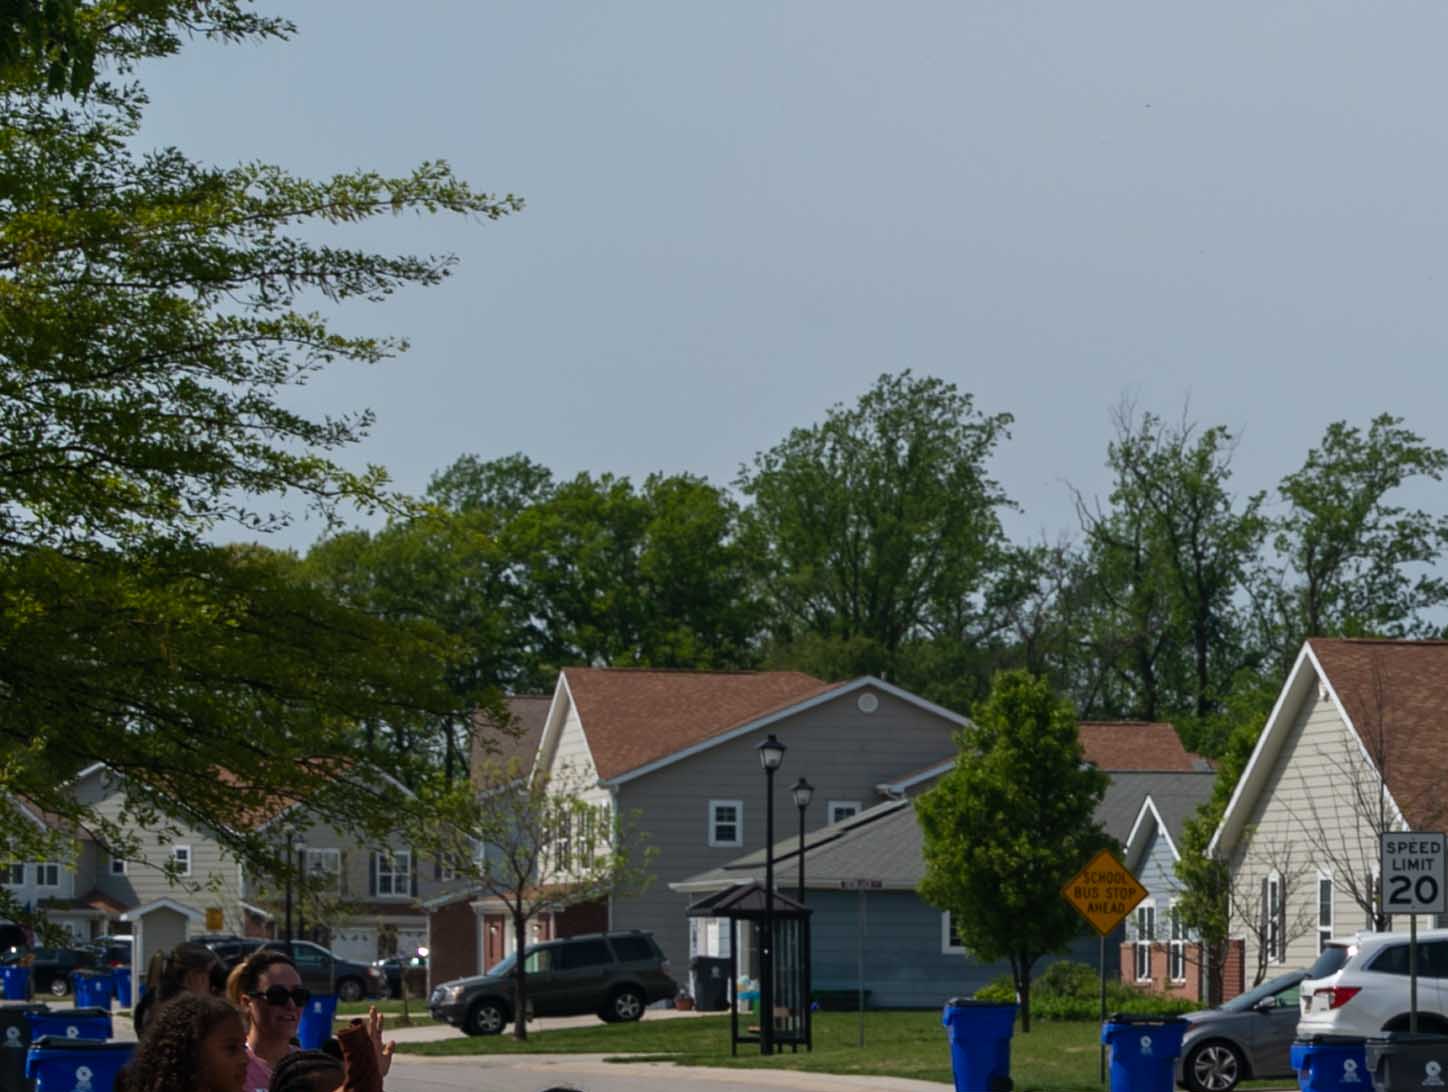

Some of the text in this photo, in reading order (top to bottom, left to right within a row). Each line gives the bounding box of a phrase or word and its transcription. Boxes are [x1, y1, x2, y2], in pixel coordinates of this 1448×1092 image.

[1386, 841, 1441, 855] SPEED
[1392, 858, 1435, 872] LIMIT
[1083, 871, 1128, 884] SCHOOL
[1074, 887, 1137, 899] BUS STOP
[1389, 875, 1439, 904] 20
[1087, 902, 1126, 914] AHEAD
